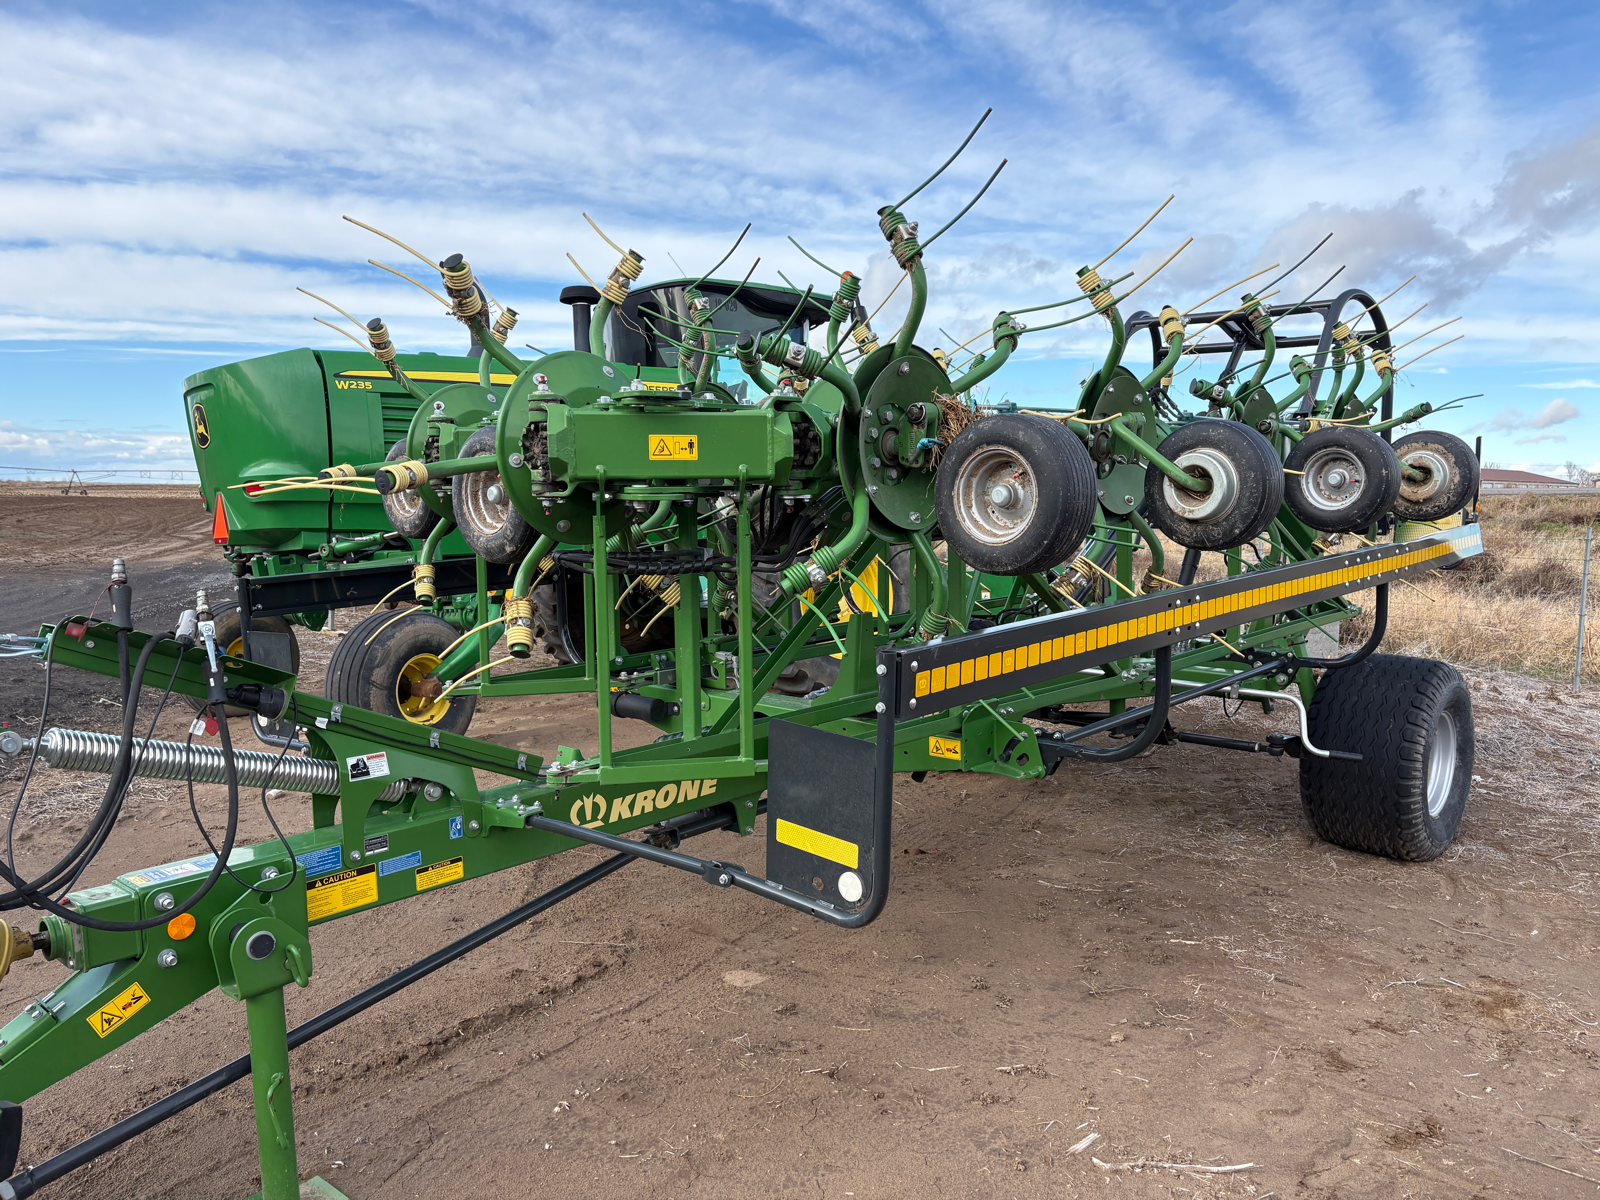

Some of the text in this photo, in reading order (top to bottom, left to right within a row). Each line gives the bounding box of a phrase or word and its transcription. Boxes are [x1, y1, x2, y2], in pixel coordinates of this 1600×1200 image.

[335, 380, 373, 390] W235
[608, 778, 718, 824] KRONE
[323, 870, 357, 885] CAUTION
